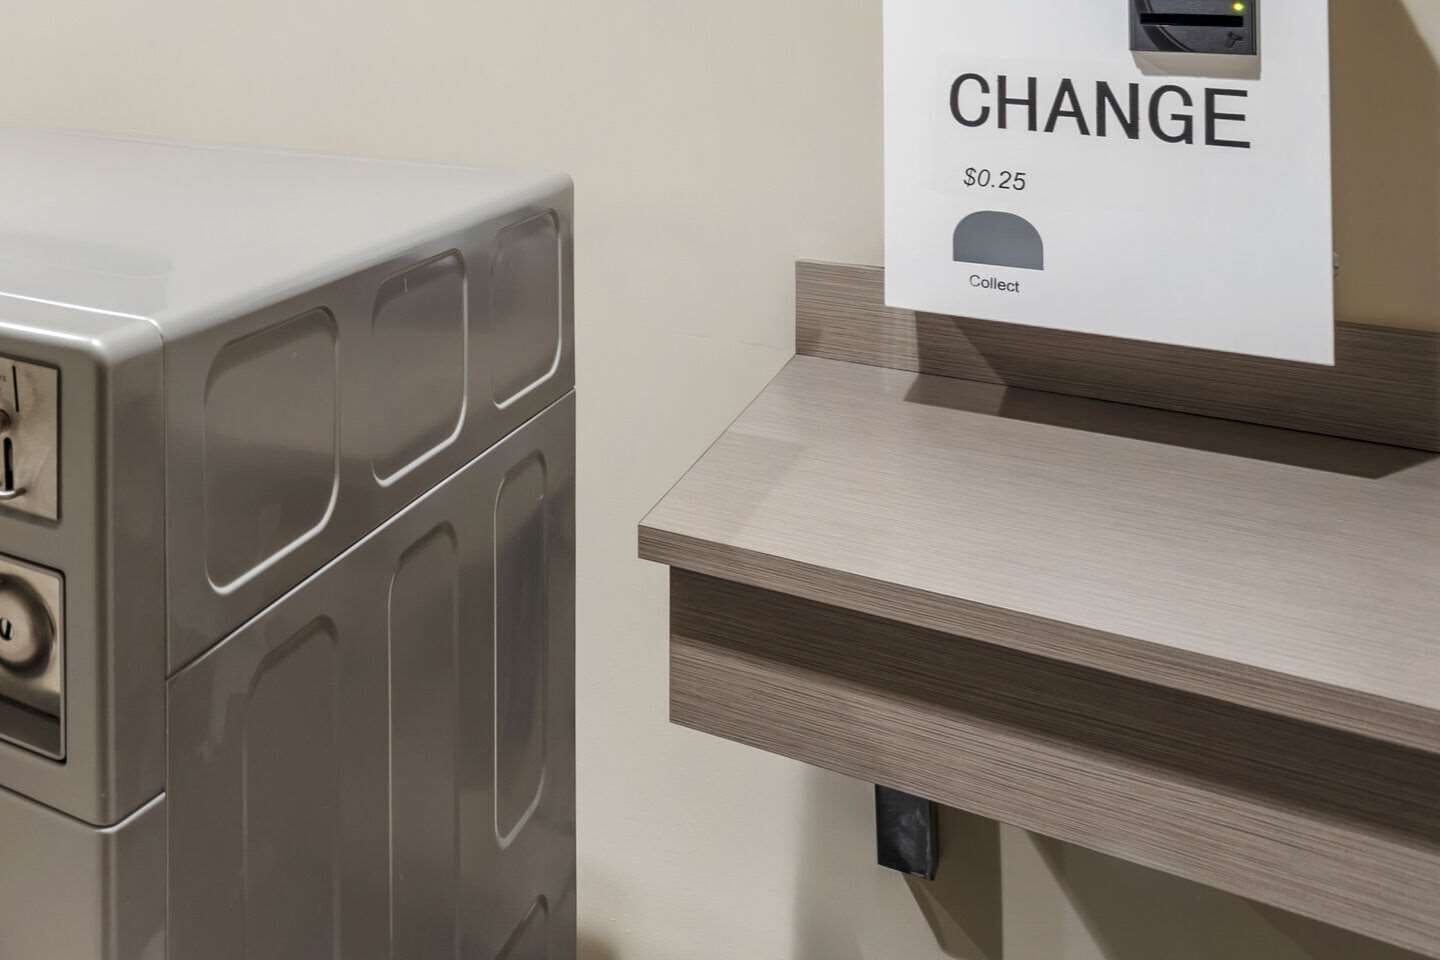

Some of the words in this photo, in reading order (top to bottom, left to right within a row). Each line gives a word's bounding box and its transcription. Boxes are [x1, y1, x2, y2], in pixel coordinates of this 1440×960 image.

[949, 73, 1251, 149] CHANGE
[963, 167, 1026, 191] $0.25
[969, 274, 1020, 293] Collect
